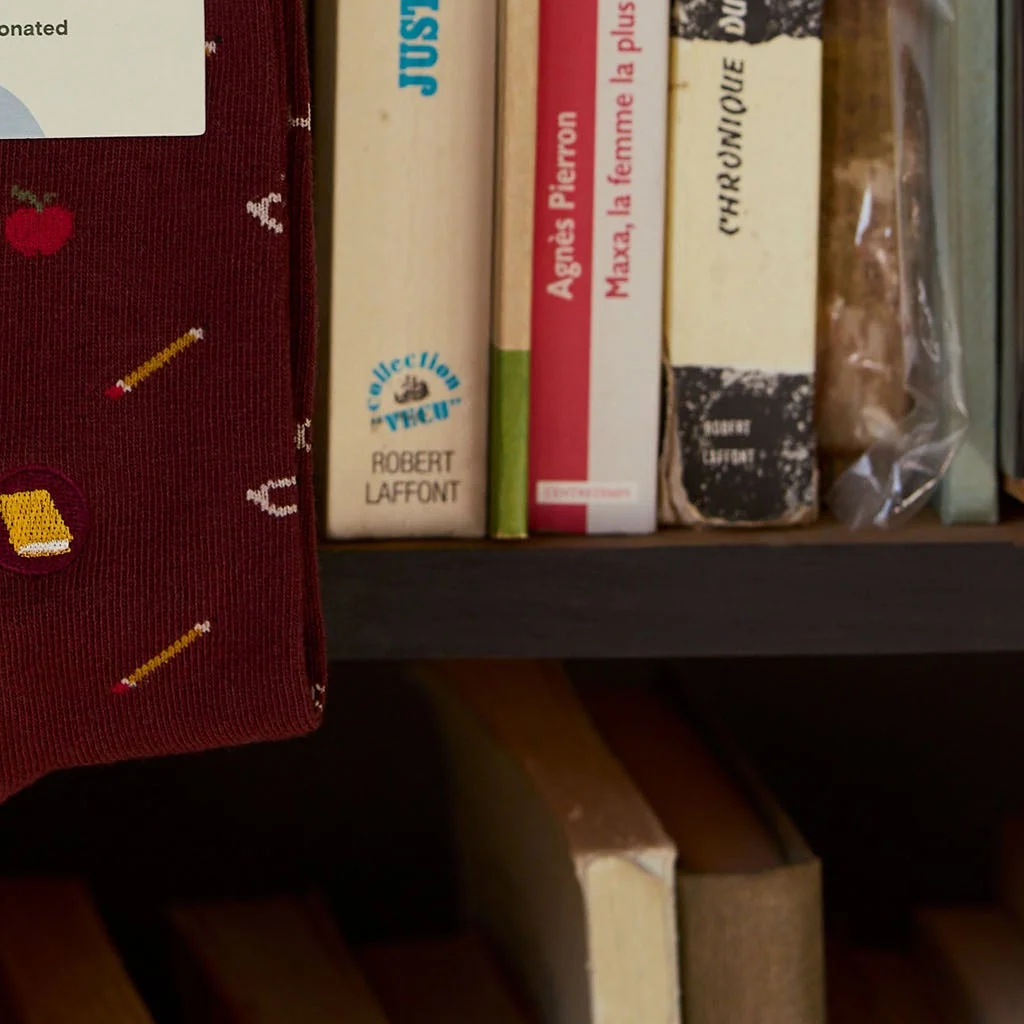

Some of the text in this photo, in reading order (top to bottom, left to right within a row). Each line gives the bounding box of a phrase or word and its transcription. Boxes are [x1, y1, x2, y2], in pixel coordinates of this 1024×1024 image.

[610, 1, 643, 53] plus
[608, 62, 636, 84] la
[606, 93, 635, 186] femme
[548, 110, 578, 211] Pierron
[606, 194, 632, 217] la
[603, 221, 636, 300] Maxa,
[371, 450, 455, 475] ROBERT
[364, 479, 461, 505] LAFFONT
